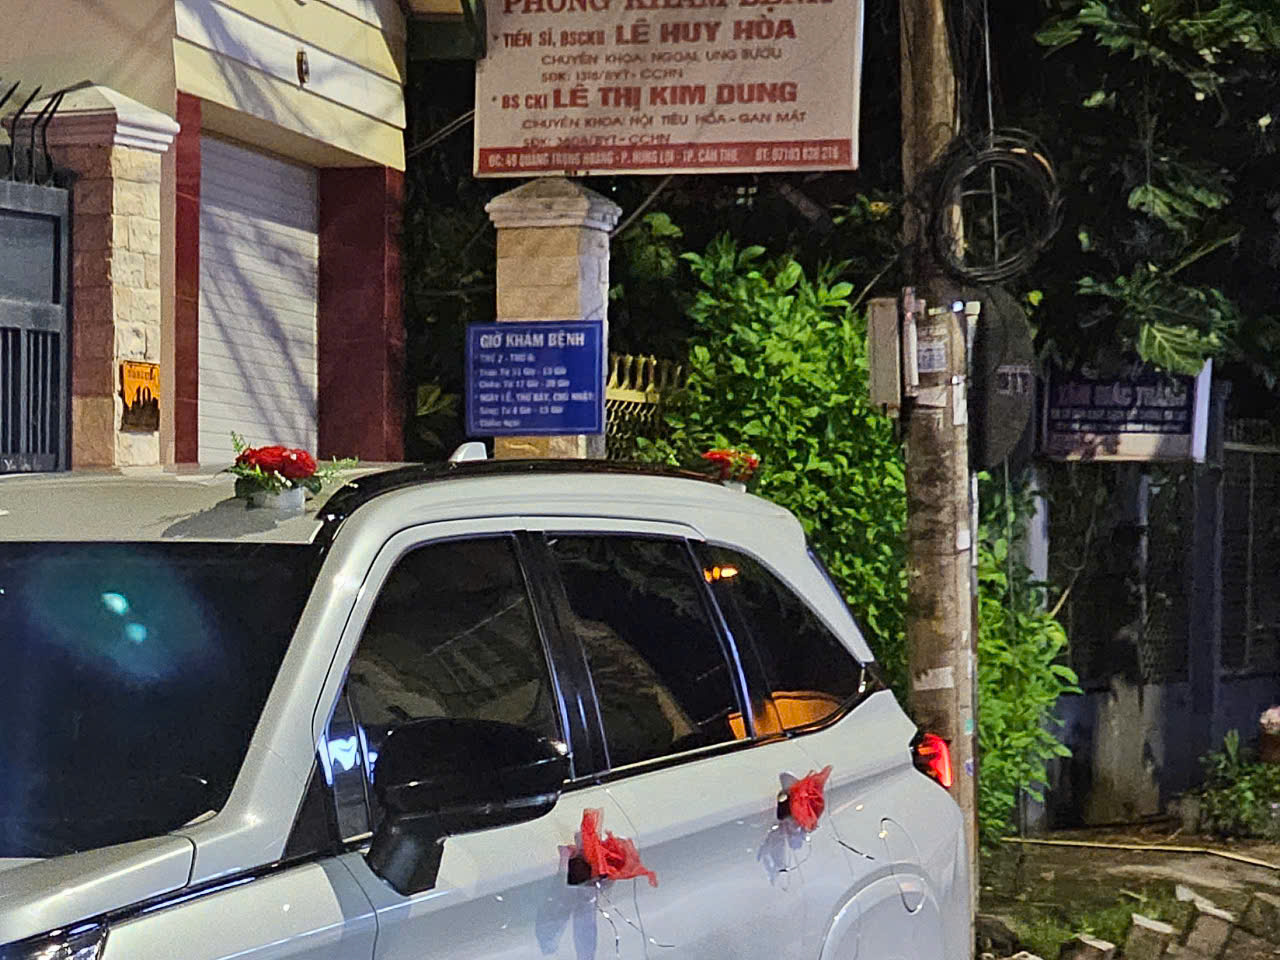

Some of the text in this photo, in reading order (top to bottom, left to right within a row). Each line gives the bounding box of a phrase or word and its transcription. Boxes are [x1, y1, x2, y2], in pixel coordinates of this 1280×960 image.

[616, 18, 650, 45] LÊ
[660, 21, 721, 43] HUY
[733, 13, 797, 40] HÒA
[501, 82, 799, 112] BS CKI LÊ THỊ KIM DUNG
[739, 112, 770, 124] GAN
[480, 330, 585, 348] GIỜ KHÁM BỆNH
